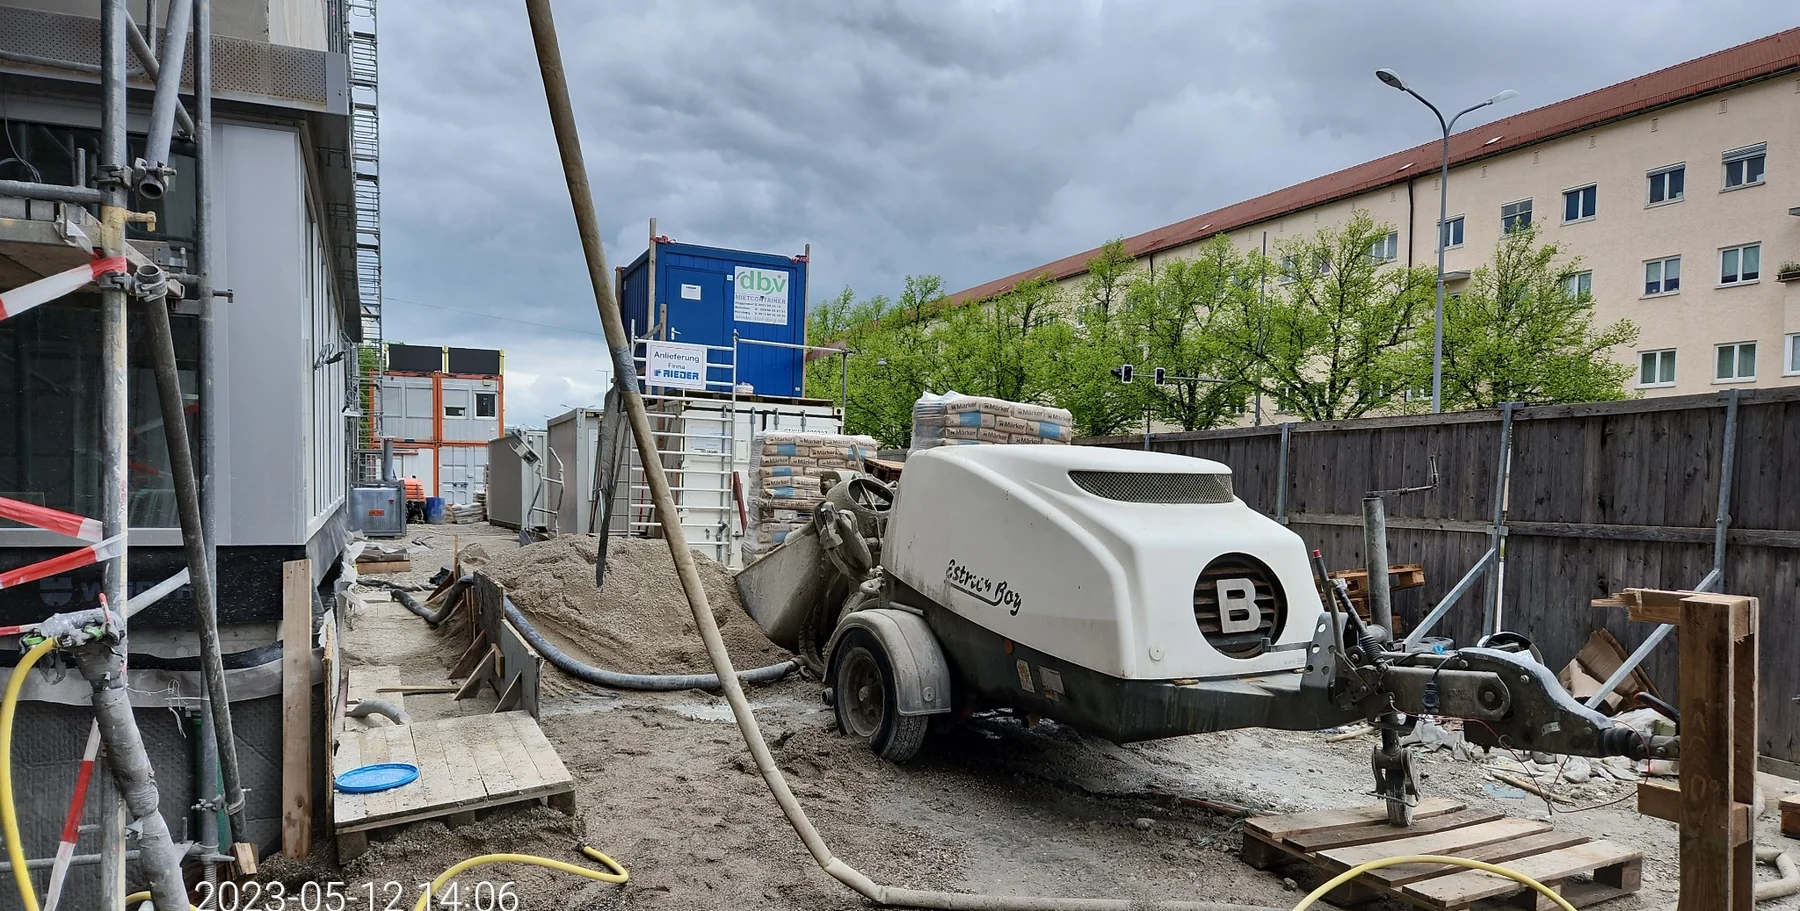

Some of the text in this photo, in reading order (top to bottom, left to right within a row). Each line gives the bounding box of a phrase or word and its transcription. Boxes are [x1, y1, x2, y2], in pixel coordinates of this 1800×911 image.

[740, 270, 787, 294] dbv
[654, 351, 700, 363] Anlieferung
[668, 362, 685, 370] Firma
[663, 369, 699, 380] RIEDER
[989, 404, 1009, 413] Märker
[1022, 409, 1044, 417] Märker
[1004, 420, 1026, 430] Märker
[987, 432, 1008, 440] Märker
[994, 581, 1022, 617] Boy
[1216, 578, 1261, 634] B
